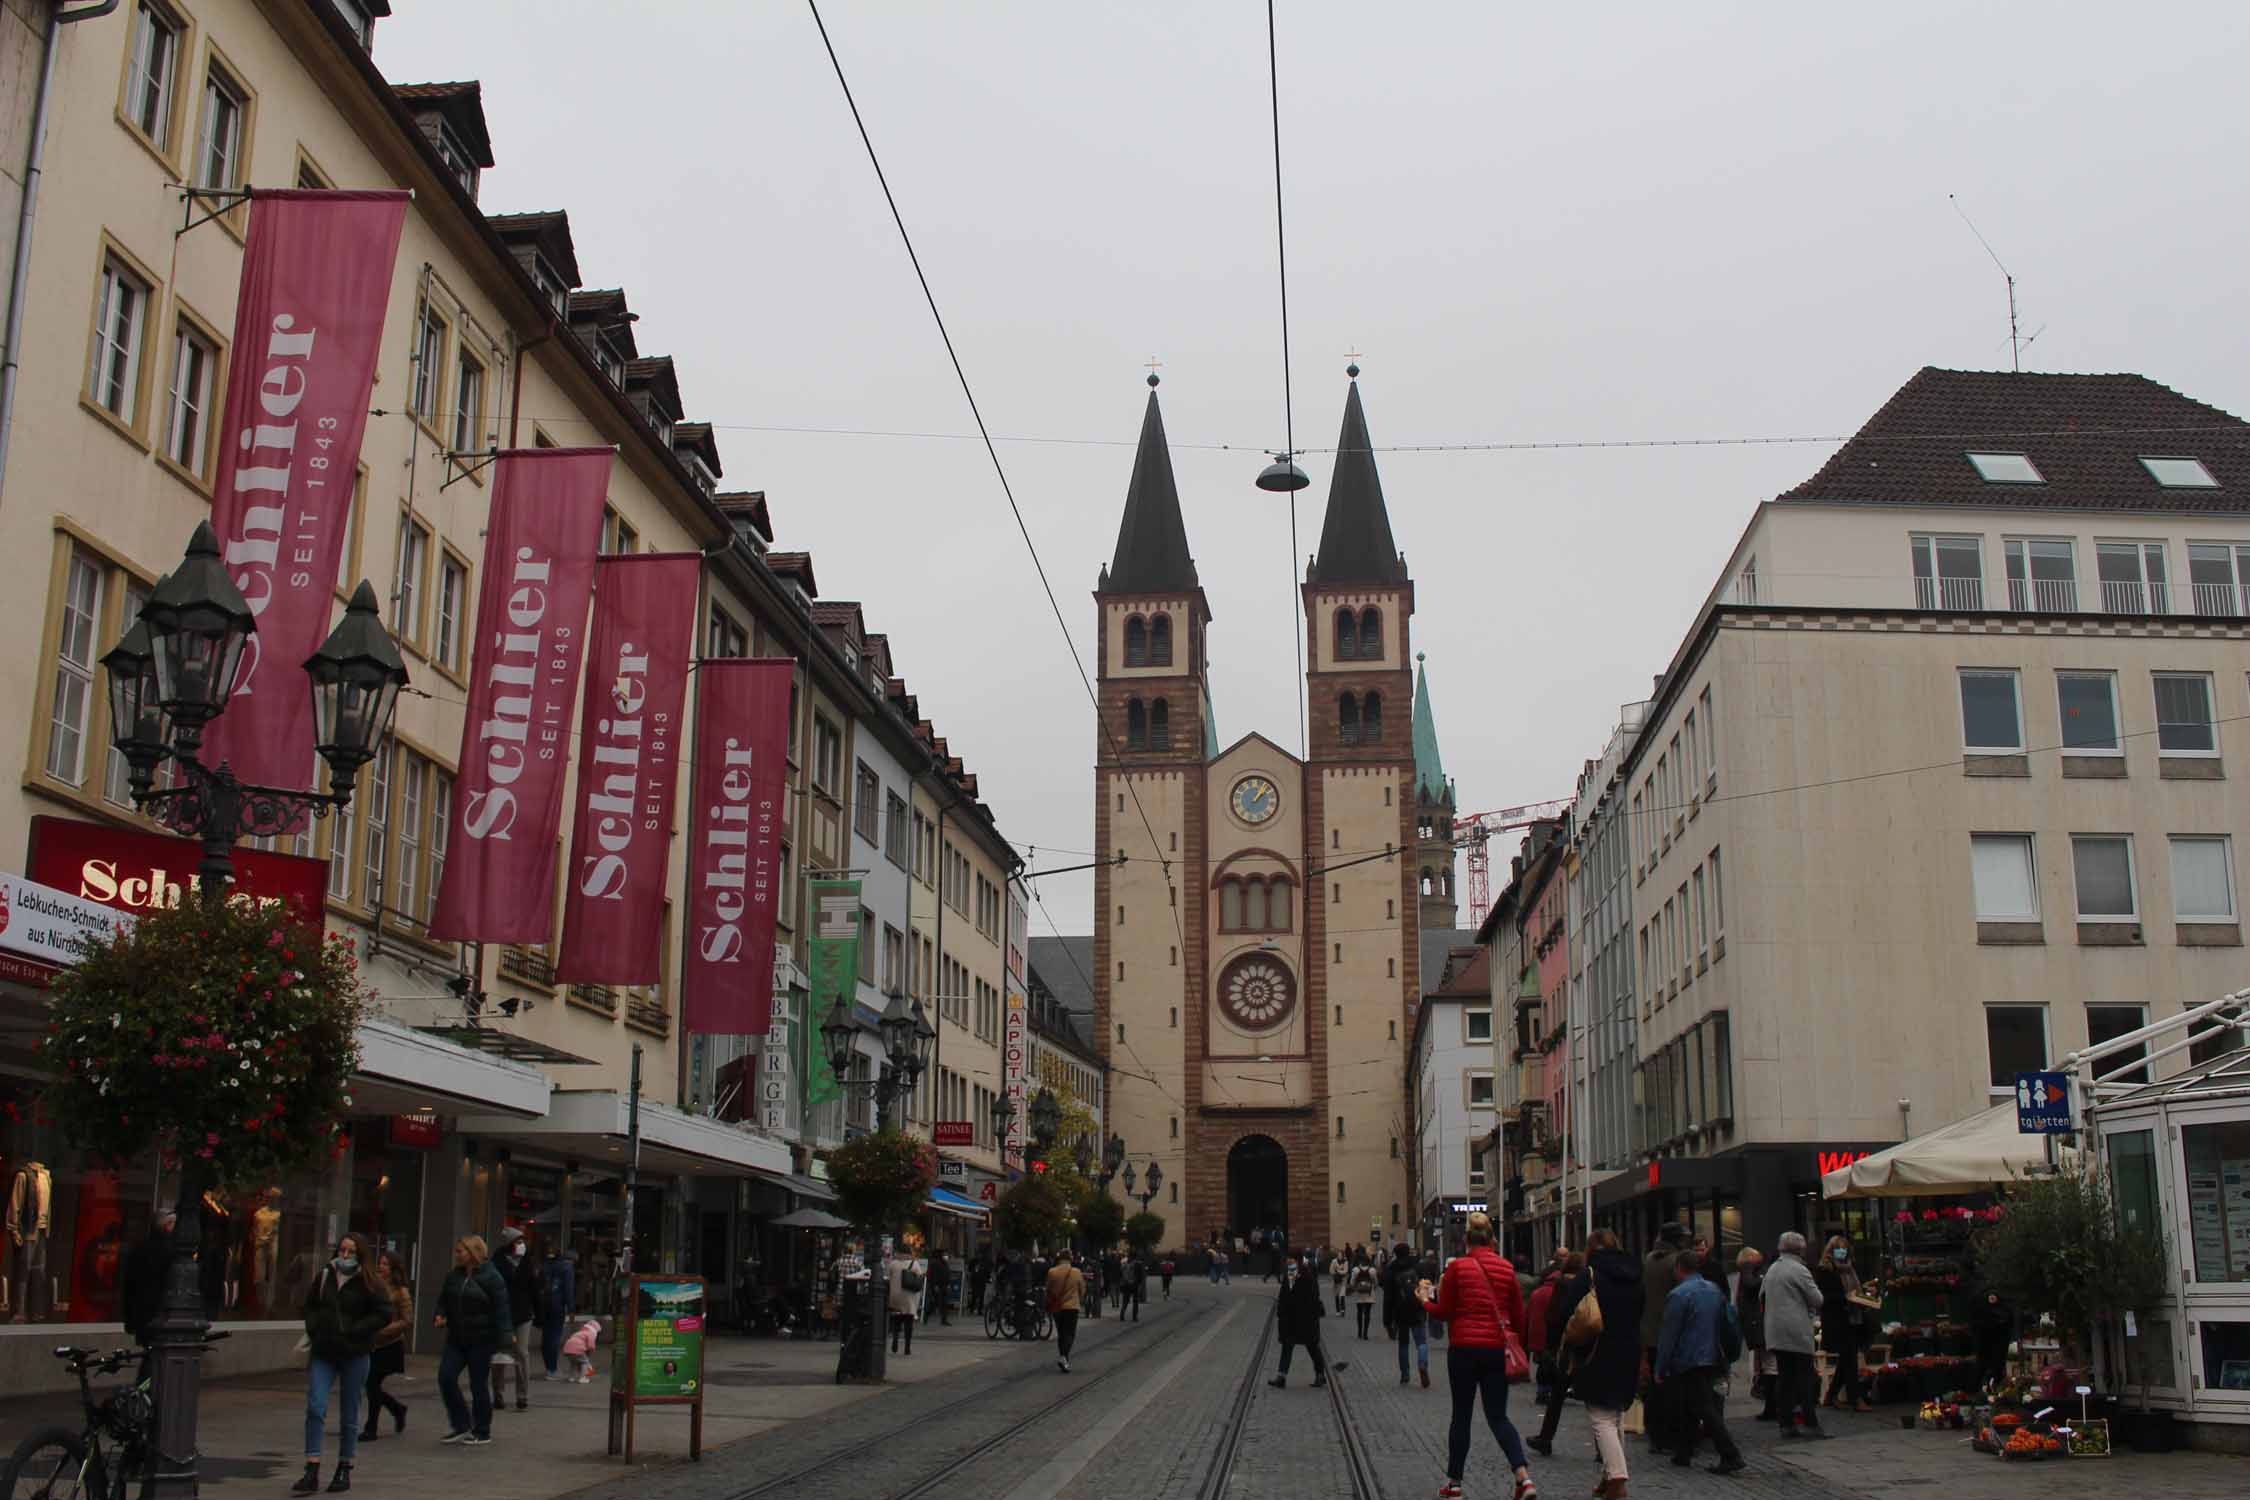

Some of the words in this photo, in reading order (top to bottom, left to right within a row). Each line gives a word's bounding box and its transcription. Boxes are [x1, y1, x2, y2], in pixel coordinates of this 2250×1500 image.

[290, 511, 319, 588] SEIT
[306, 416, 338, 489] 1843
[464, 546, 551, 841] Schlier
[539, 701, 561, 760] SEIT
[550, 626, 571, 685] 1843
[652, 711, 668, 764] 1843
[580, 642, 649, 900] Schlier
[645, 779, 663, 830] SEIT
[759, 800, 772, 844] 1843
[701, 737, 752, 963] Schlier
[754, 857, 768, 902] SEIT
[27, 928, 45, 944] aus
[943, 1164, 960, 1175] Tee
